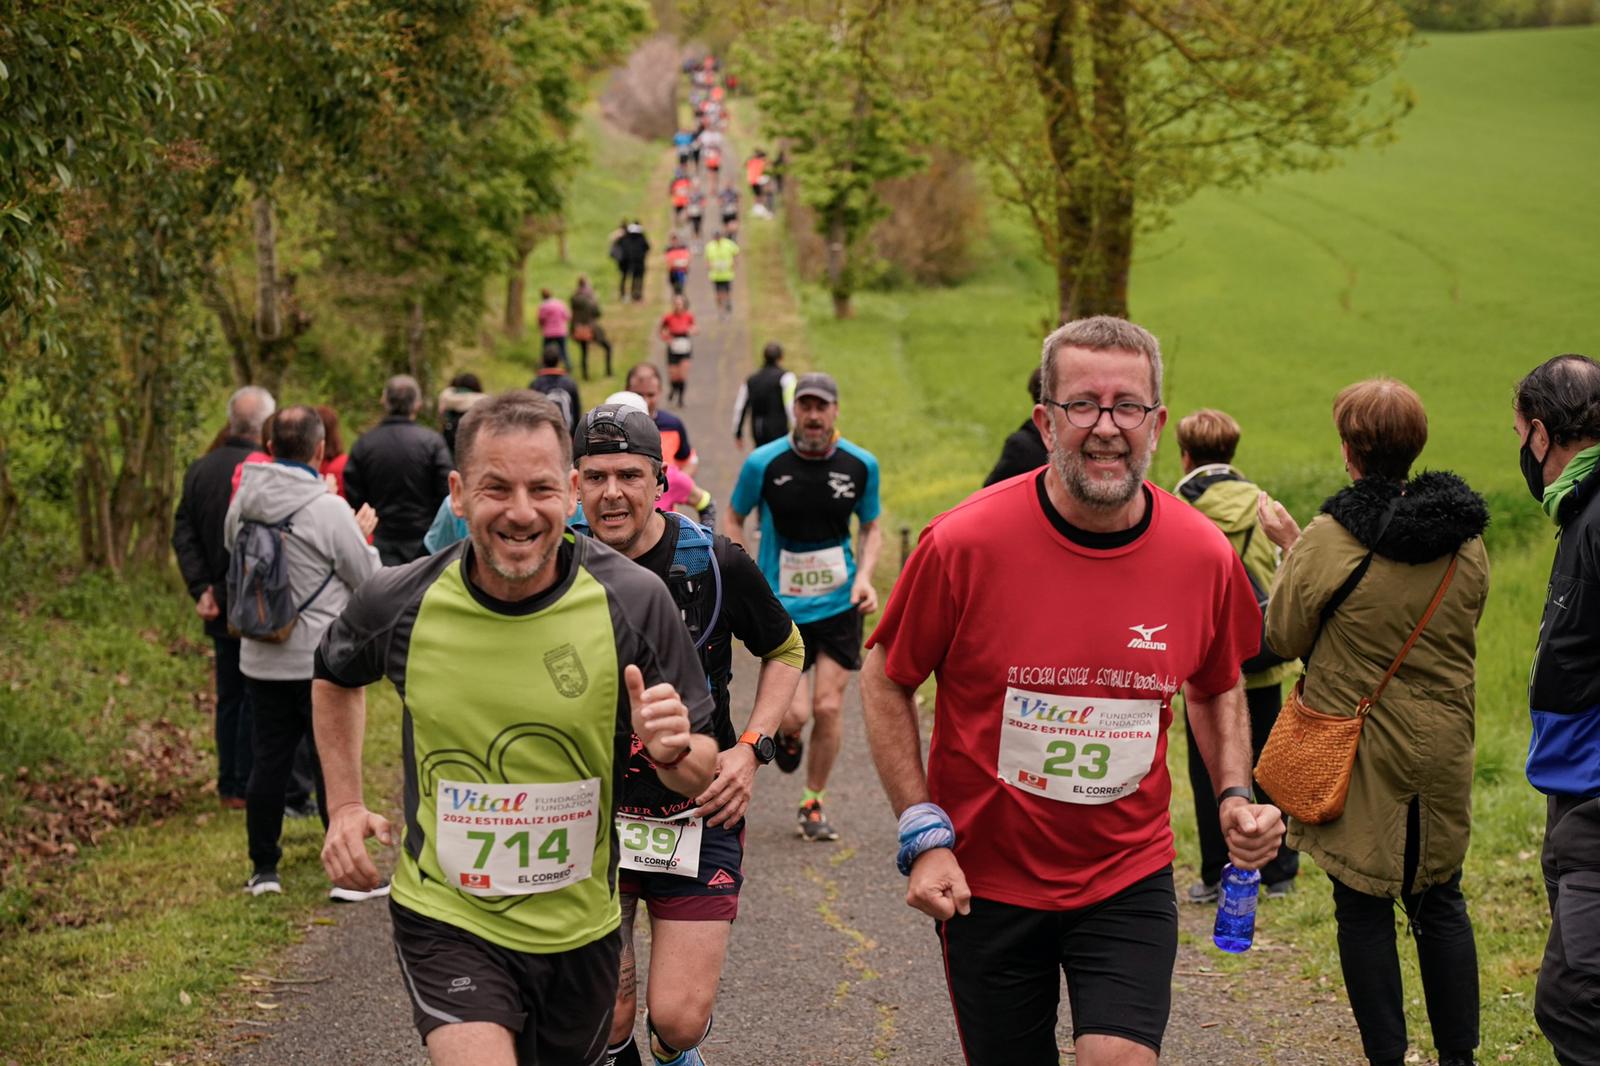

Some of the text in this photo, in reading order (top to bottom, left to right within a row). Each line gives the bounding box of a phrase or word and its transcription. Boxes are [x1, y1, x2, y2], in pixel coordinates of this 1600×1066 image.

[791, 569, 833, 586] 405
[1013, 696, 1095, 725] Vital
[1099, 711, 1153, 720] FUNDACIÓN
[1008, 718, 1152, 739] 2022 ESTIBALIZ IGOERA
[1099, 718, 1152, 727] FUNDAZIOA
[1043, 740, 1111, 780] 23
[1073, 785, 1123, 795] EL CORREO
[444, 786, 528, 814] Vital
[443, 810, 593, 826] 2022 ESTIBALIZ IGOERA
[616, 822, 676, 854] 39
[466, 828, 570, 869] 714
[518, 875, 530, 884] EL
[532, 869, 571, 882] CORREO
